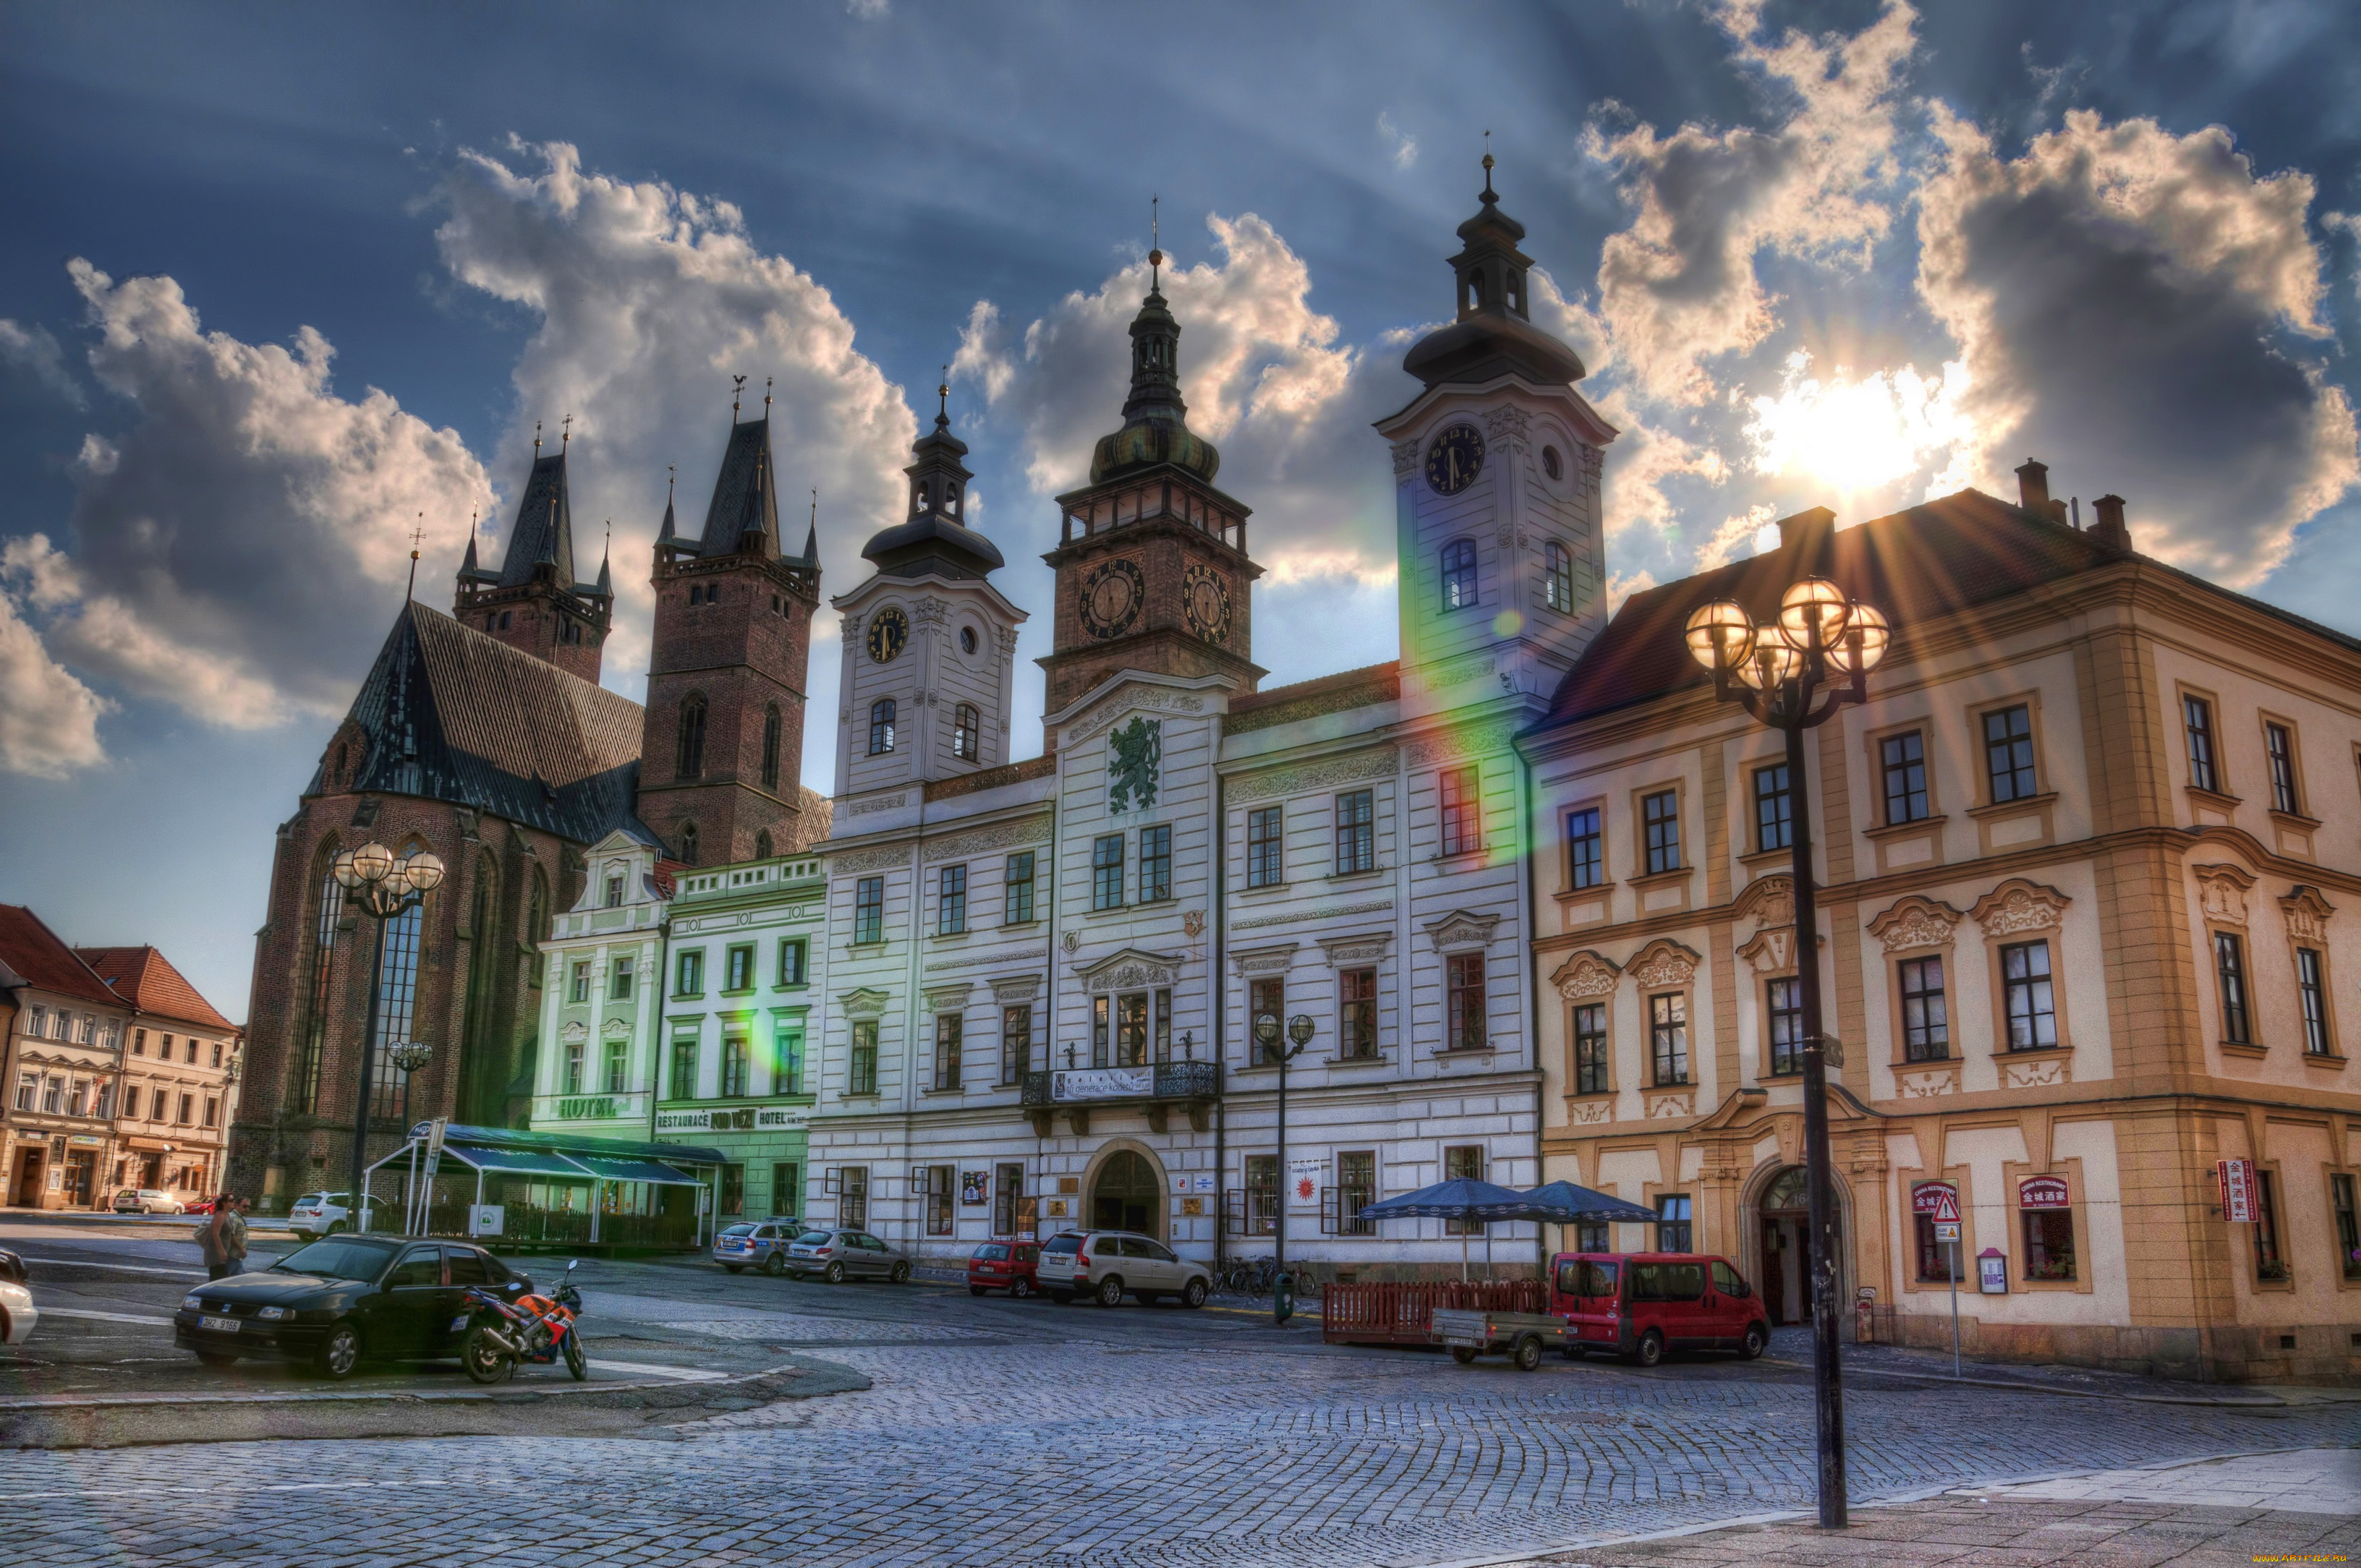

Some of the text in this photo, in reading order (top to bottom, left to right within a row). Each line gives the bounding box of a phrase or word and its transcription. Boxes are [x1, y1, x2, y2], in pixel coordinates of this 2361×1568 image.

[1450, 429, 1460, 439] 12
[1465, 429, 1468, 438] 1
[1441, 435, 1446, 446] 11
[1471, 435, 1479, 444] 2
[1432, 448, 1441, 459] 10
[1475, 446, 1481, 456] 3
[1429, 463, 1436, 472] 9
[1470, 460, 1477, 469] 4
[1433, 474, 1439, 484] 8
[1463, 474, 1469, 482] 5
[1441, 481, 1447, 490] 7
[1108, 560, 1117, 571] 12
[1124, 561, 1127, 571] 1
[1195, 566, 1199, 576] 11
[1095, 568, 1101, 579] 11
[1133, 570, 1139, 580] 2
[1204, 566, 1211, 577] 12
[1187, 573, 1193, 584] 10
[1217, 576, 1219, 586] 1
[1085, 584, 1092, 594] 10
[1136, 586, 1141, 596] 3
[1184, 588, 1188, 599] 9
[1223, 591, 1227, 602] 2
[1081, 601, 1086, 612] 9
[1132, 603, 1139, 613] 4
[1187, 607, 1191, 618] 8
[1225, 608, 1230, 619] 3
[1085, 617, 1089, 627] 8
[1123, 618, 1128, 629] 5
[1195, 622, 1199, 633] 7
[1094, 626, 1099, 636] 7
[1108, 626, 1113, 636] 6
[1222, 624, 1227, 635] 4
[1205, 631, 1209, 642] 6
[1215, 633, 1220, 644] 5
[1068, 1073, 1134, 1084] galerie
[1075, 1083, 1108, 1095] generace
[1110, 1082, 1133, 1092] kodetů
[558, 1098, 616, 1117] HOTEL
[658, 1114, 709, 1128] RESTAURACE
[710, 1112, 732, 1129] POD
[760, 1112, 786, 1125] HOTEL
[1914, 1187, 1927, 1196] CHINA
[2021, 1180, 2066, 1192] CHINA RESTAURANT
[2229, 1162, 2245, 1211] 金城酒家
[1795, 1193, 1809, 1204] 16
[2022, 1190, 2066, 1202] 金城酒家
[203, 1318, 238, 1331] 3H2 9166
